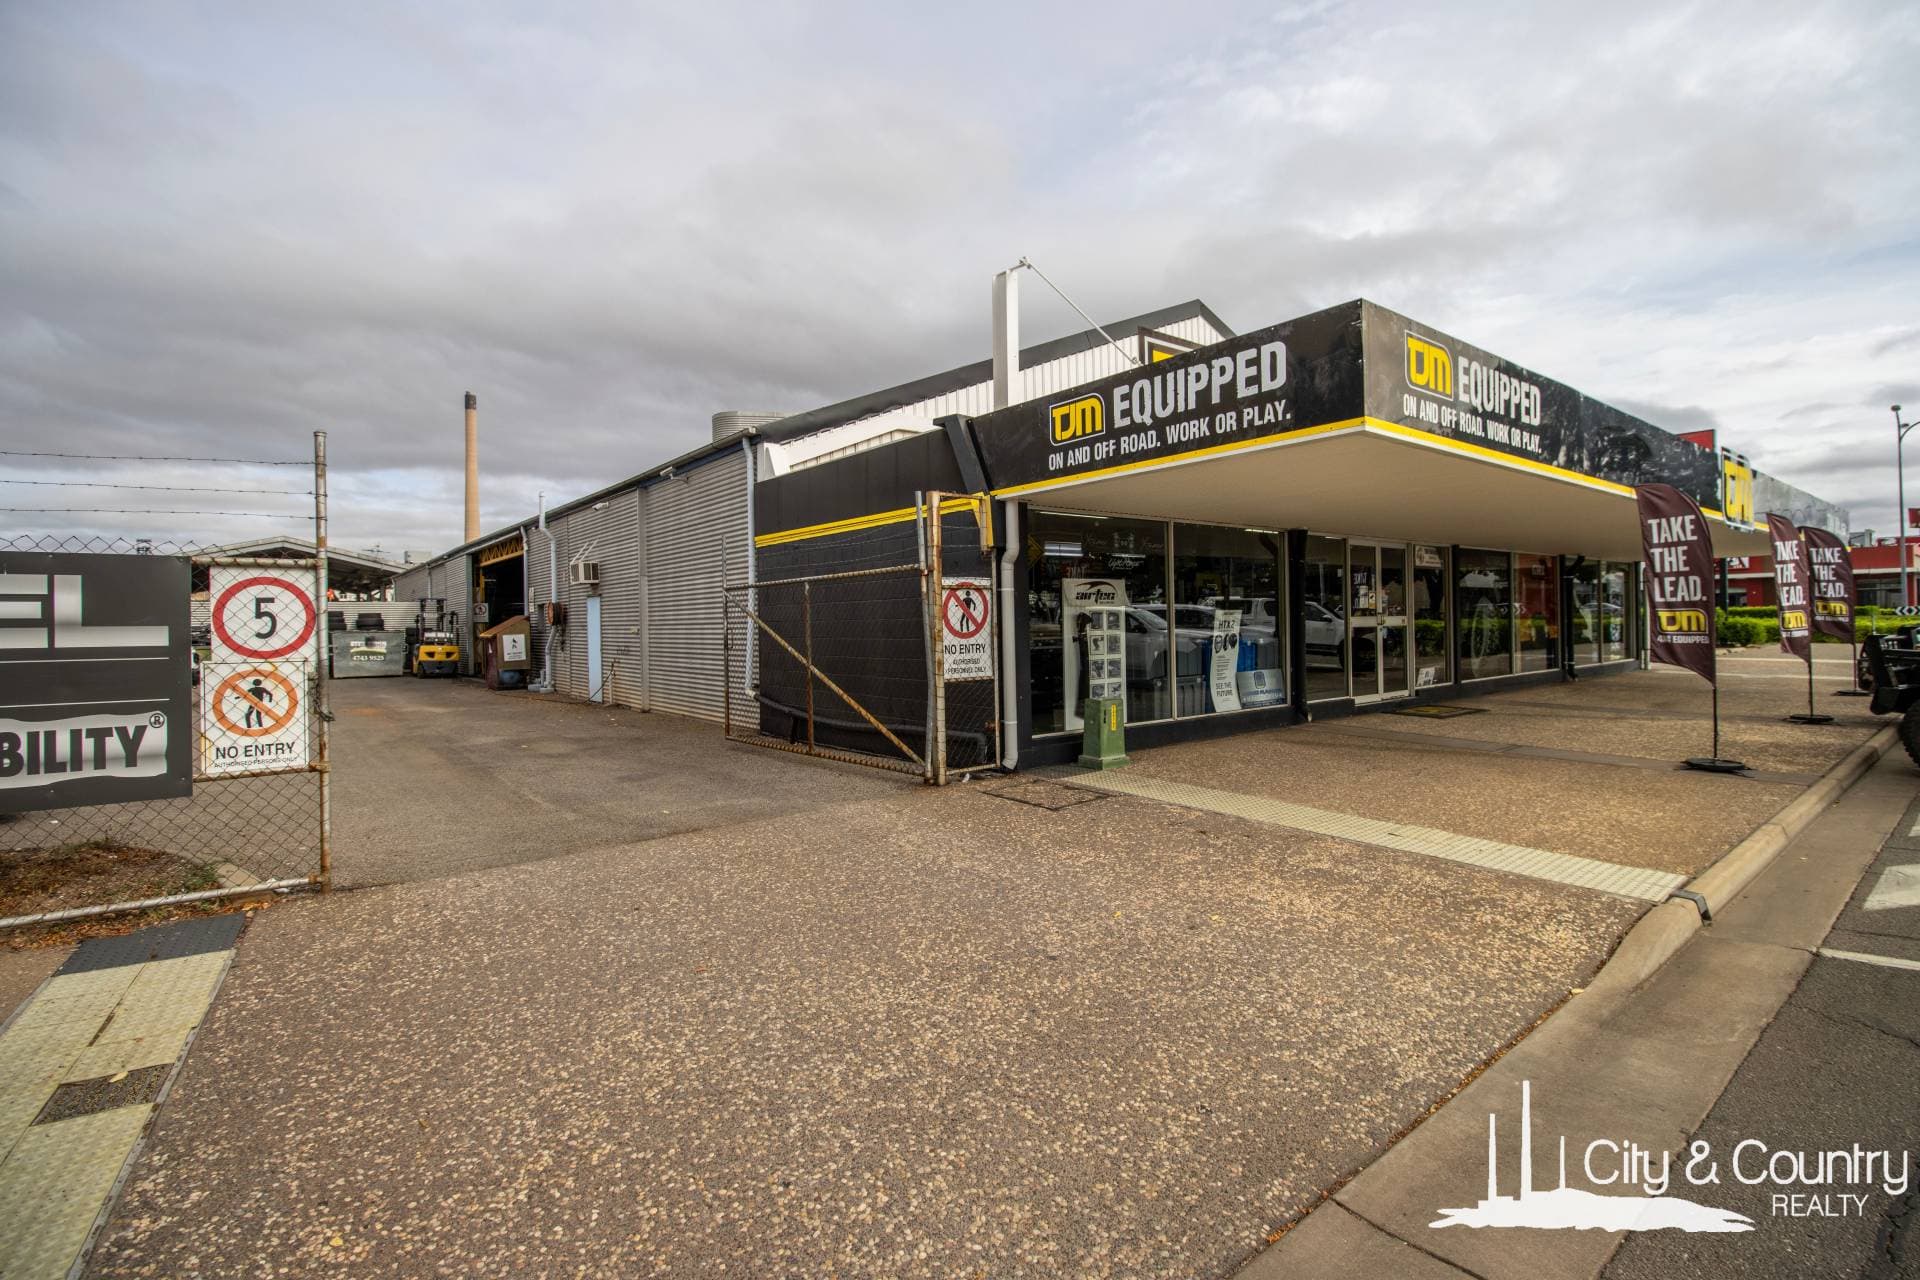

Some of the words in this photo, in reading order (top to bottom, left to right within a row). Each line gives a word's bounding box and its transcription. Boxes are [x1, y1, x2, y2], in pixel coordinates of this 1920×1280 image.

[1113, 341, 1287, 428] EQUIPPED
[1457, 355, 1541, 427] EQUIPPED
[1048, 453, 1064, 471] ON
[1067, 446, 1090, 467] AND
[1094, 440, 1117, 462] OFF
[1120, 430, 1161, 455] ROAD.
[1165, 416, 1211, 445] WORK
[1215, 412, 1237, 436] OR
[1243, 399, 1292, 432] PLAY.
[1403, 393, 1417, 418] ON
[1419, 400, 1439, 424] AND
[1441, 406, 1457, 429] OFF
[1459, 411, 1485, 437] ROAD.
[1486, 419, 1510, 445] WORK
[1510, 428, 1522, 448] OR
[1522, 432, 1542, 453] PLAY.
[1647, 514, 1698, 544] TAKE
[1650, 546, 1690, 573] THE
[1775, 540, 1800, 560] TAKE
[1809, 547, 1843, 563] TAKE
[1775, 563, 1797, 583] THE
[1812, 565, 1837, 581] THE
[1653, 575, 1708, 603] LEAD.
[1814, 582, 1848, 598] LEAD.
[254, 596, 277, 640] 5
[944, 644, 957, 655] NO
[959, 643, 986, 655] ENTRY
[215, 746, 239, 760] NO
[244, 741, 295, 758] ENTRY
